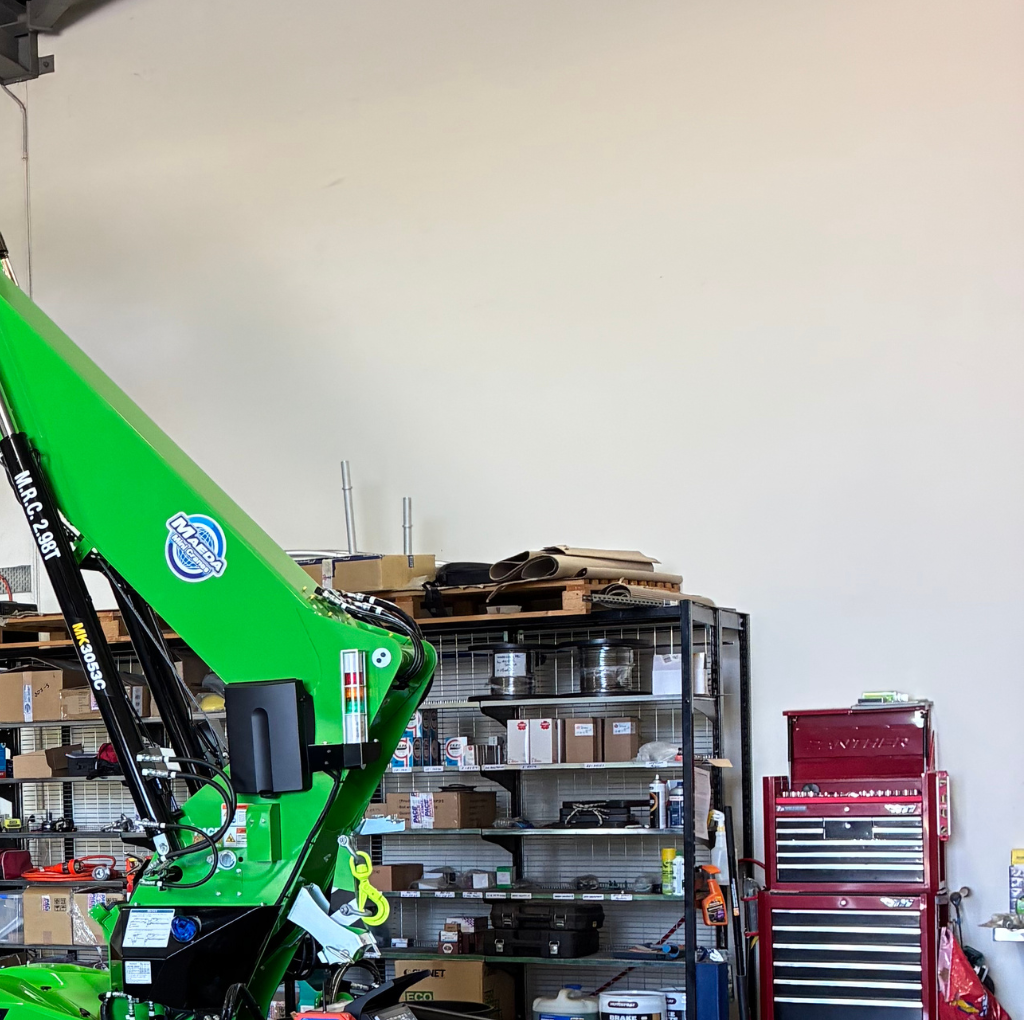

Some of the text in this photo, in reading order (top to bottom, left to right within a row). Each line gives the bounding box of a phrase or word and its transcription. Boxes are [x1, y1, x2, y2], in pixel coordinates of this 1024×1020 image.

[14, 470, 61, 561] M.R.C. 2.98T
[169, 515, 224, 574] MAEDA
[171, 533, 189, 551] Mini
[72, 622, 107, 691] MK3053C
[406, 992, 433, 1001] ECO
